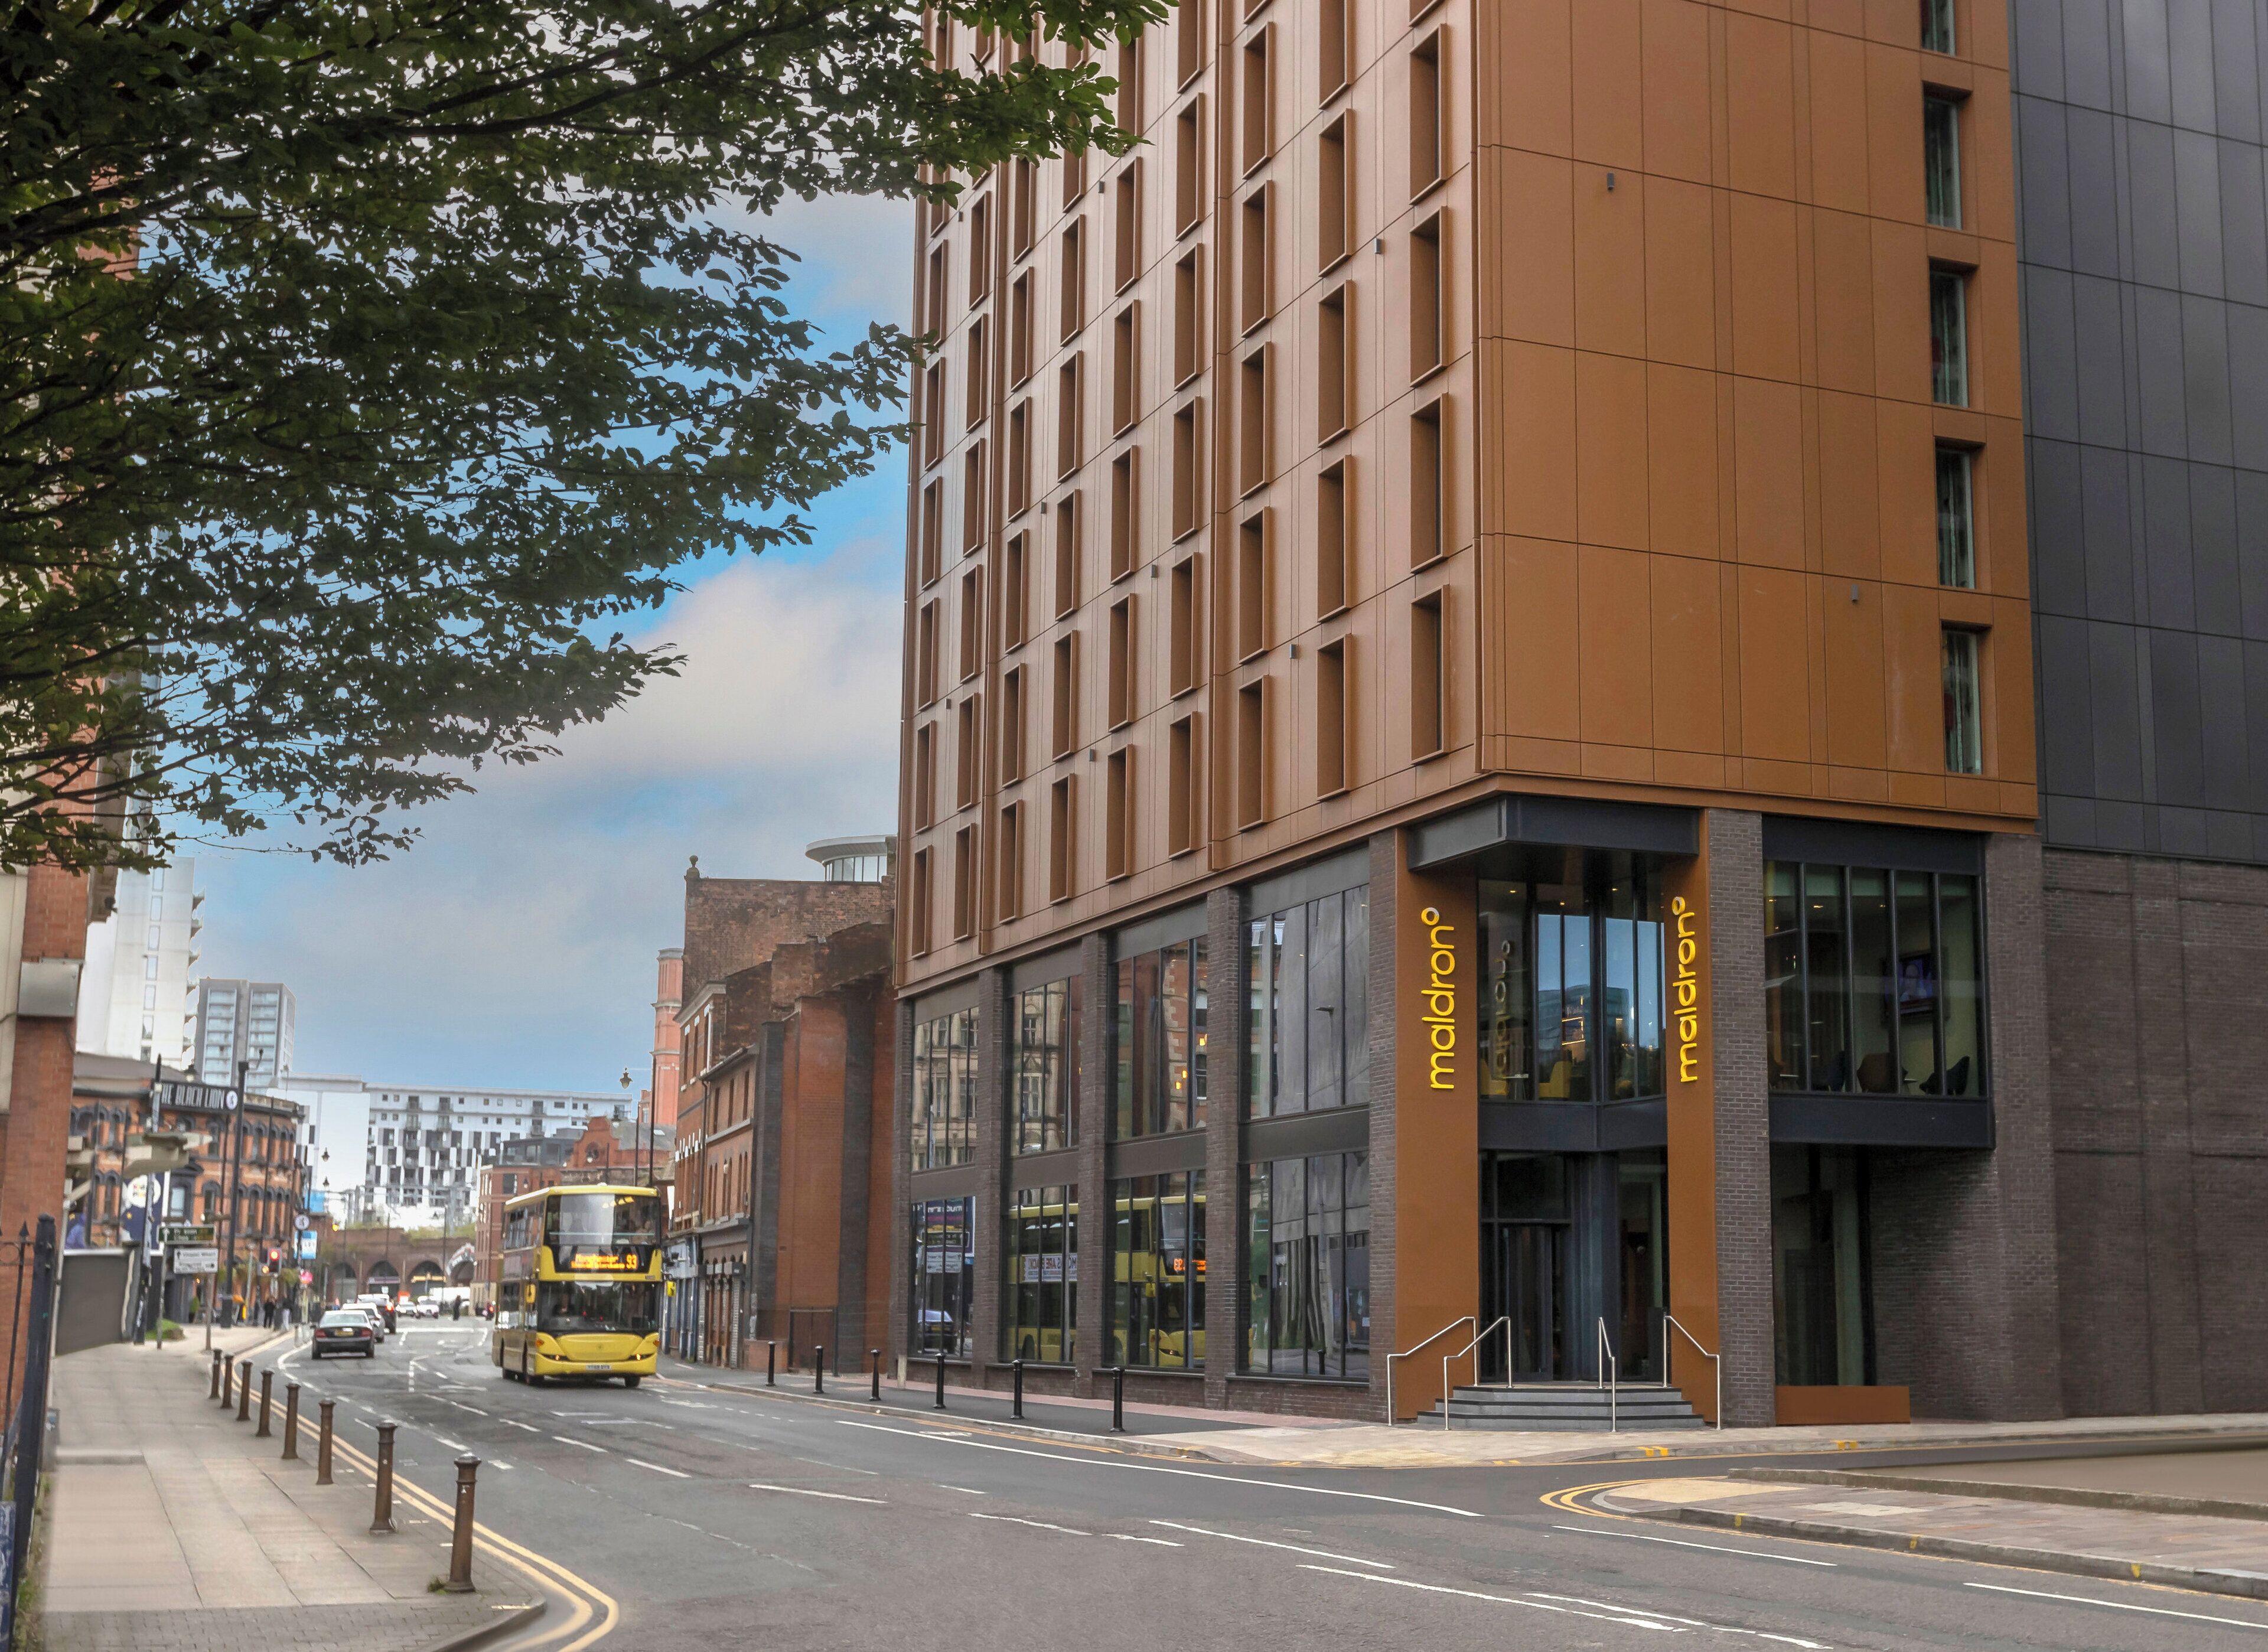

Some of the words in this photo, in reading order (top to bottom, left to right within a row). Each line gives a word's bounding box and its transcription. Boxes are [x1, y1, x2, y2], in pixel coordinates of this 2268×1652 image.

[175, 1084, 203, 1108] BLACK
[204, 1087, 225, 1110] LION
[625, 1253, 638, 1269] 93
